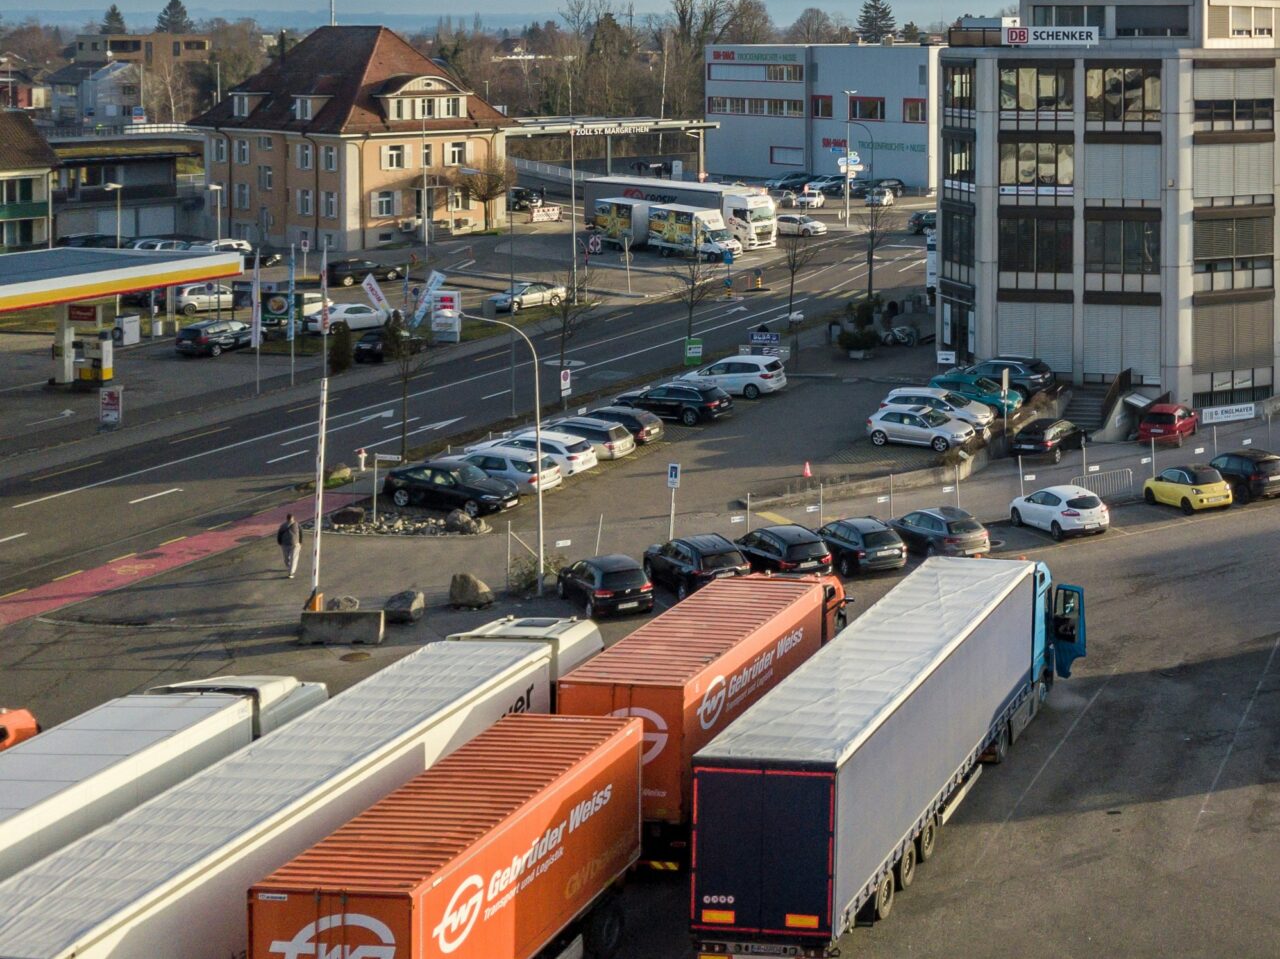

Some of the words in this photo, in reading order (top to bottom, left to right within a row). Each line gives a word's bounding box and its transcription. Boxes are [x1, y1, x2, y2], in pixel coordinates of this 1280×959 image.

[1032, 30, 1094, 41] SCHENKER
[604, 126, 649, 135] MARGRETHEN
[1220, 406, 1253, 416] ENGLMAYER
[727, 648, 776, 698] Gebrüder
[776, 627, 804, 660] Weiss
[487, 821, 567, 902] Gebrüder
[568, 783, 613, 836] Weiss
[483, 887, 520, 921] Transport
[520, 872, 535, 892] und
[536, 846, 565, 876] Logistik
